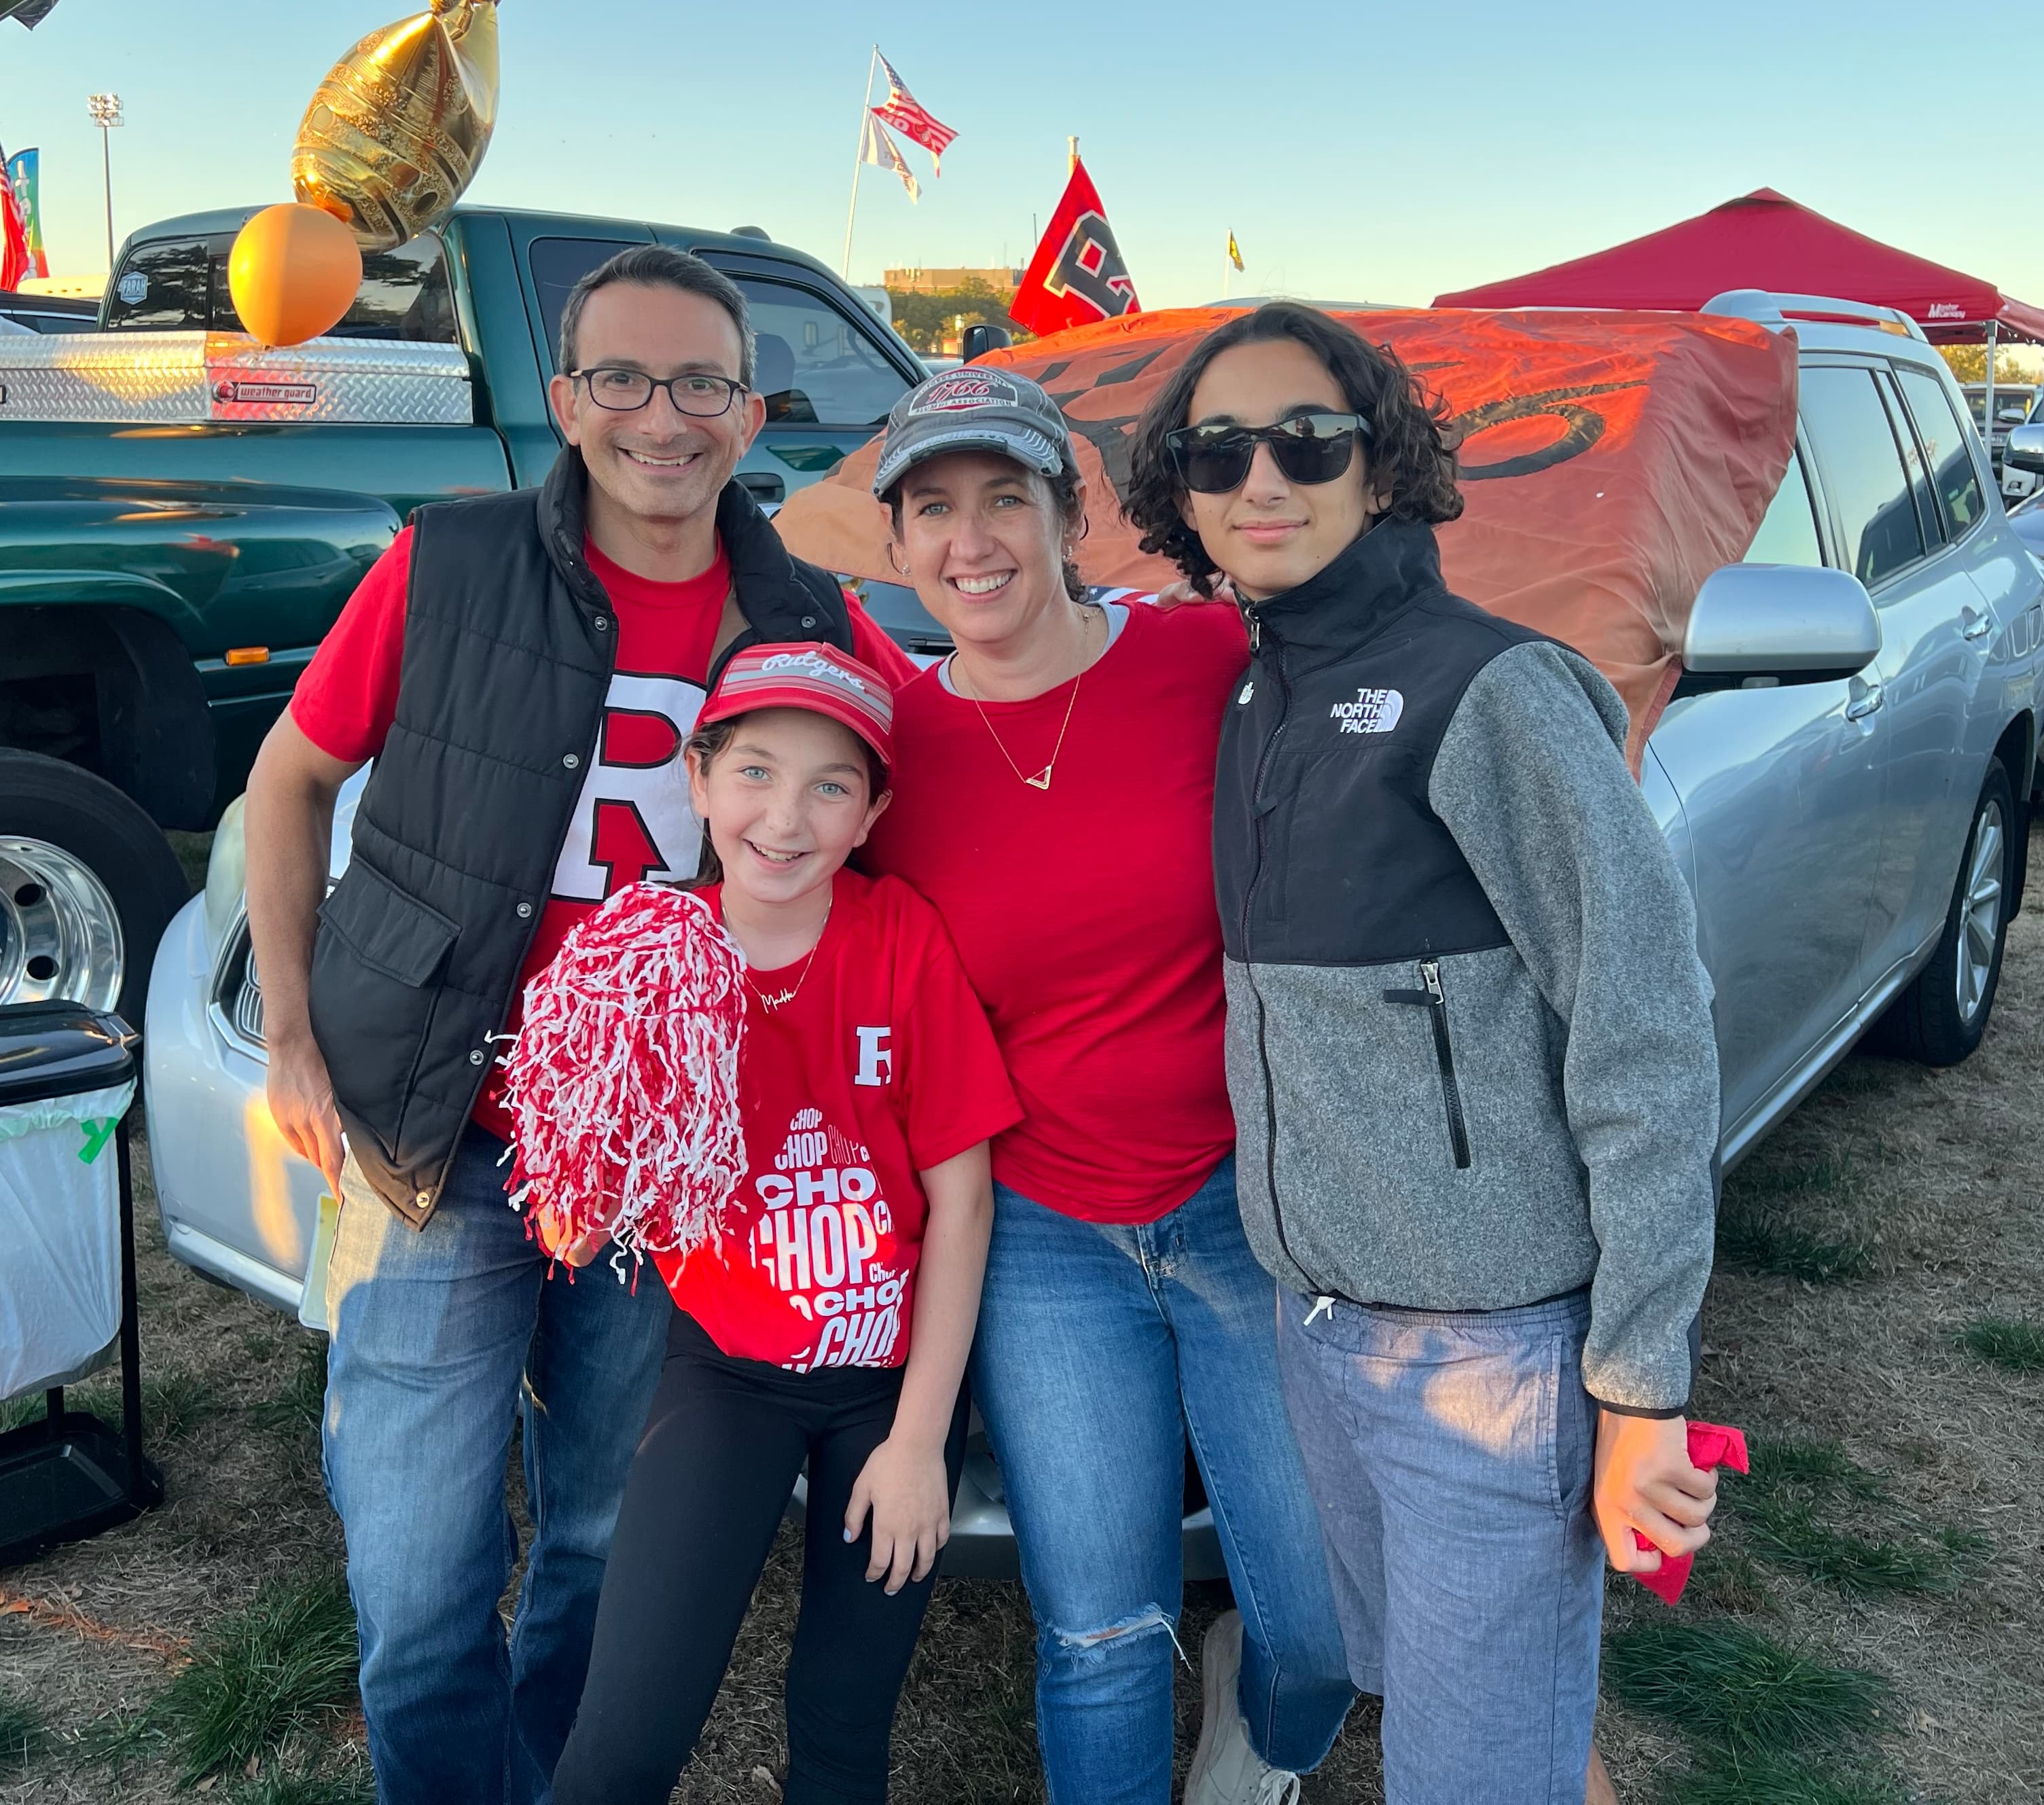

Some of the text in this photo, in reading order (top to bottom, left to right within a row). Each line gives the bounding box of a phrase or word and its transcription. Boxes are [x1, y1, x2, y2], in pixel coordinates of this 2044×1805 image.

[1043, 209, 1136, 319] R
[240, 387, 311, 398] weather guard
[925, 378, 999, 405] 1766
[952, 397, 1012, 407] ASSOCIATION
[761, 651, 865, 691] Rutgers
[1357, 688, 1387, 704] THE
[1330, 702, 1383, 718] NORTH
[1340, 719, 1376, 734] FACE
[549, 673, 708, 902] R
